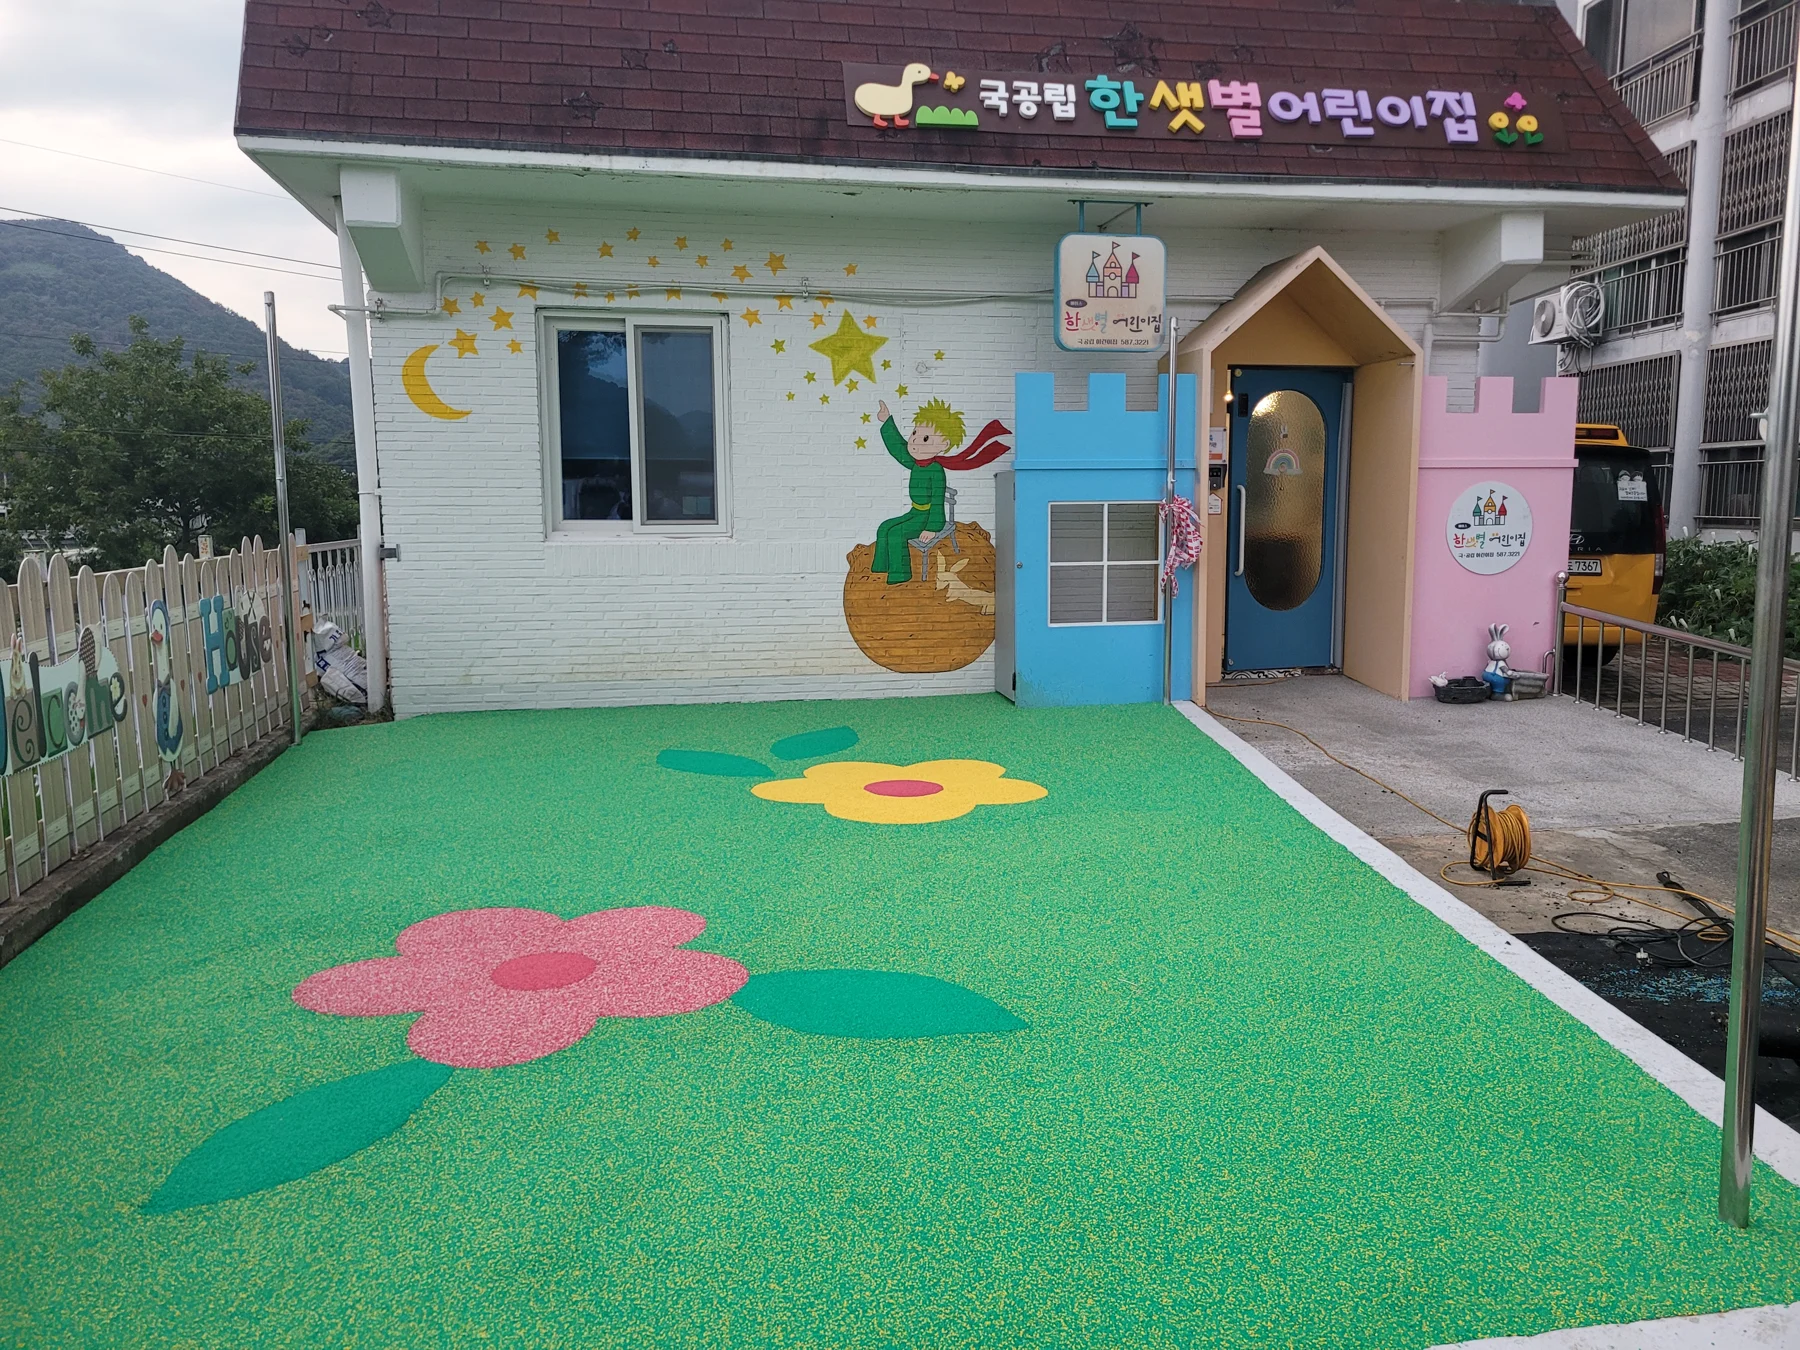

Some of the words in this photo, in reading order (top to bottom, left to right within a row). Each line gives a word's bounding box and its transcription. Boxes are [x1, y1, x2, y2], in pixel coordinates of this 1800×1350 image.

[979, 79, 1076, 121] 국공립
[1113, 313, 1162, 333] 어린이집
[1489, 532, 1526, 547] 어린이집
[1574, 561, 1599, 571] 7367
[199, 594, 272, 694] House
